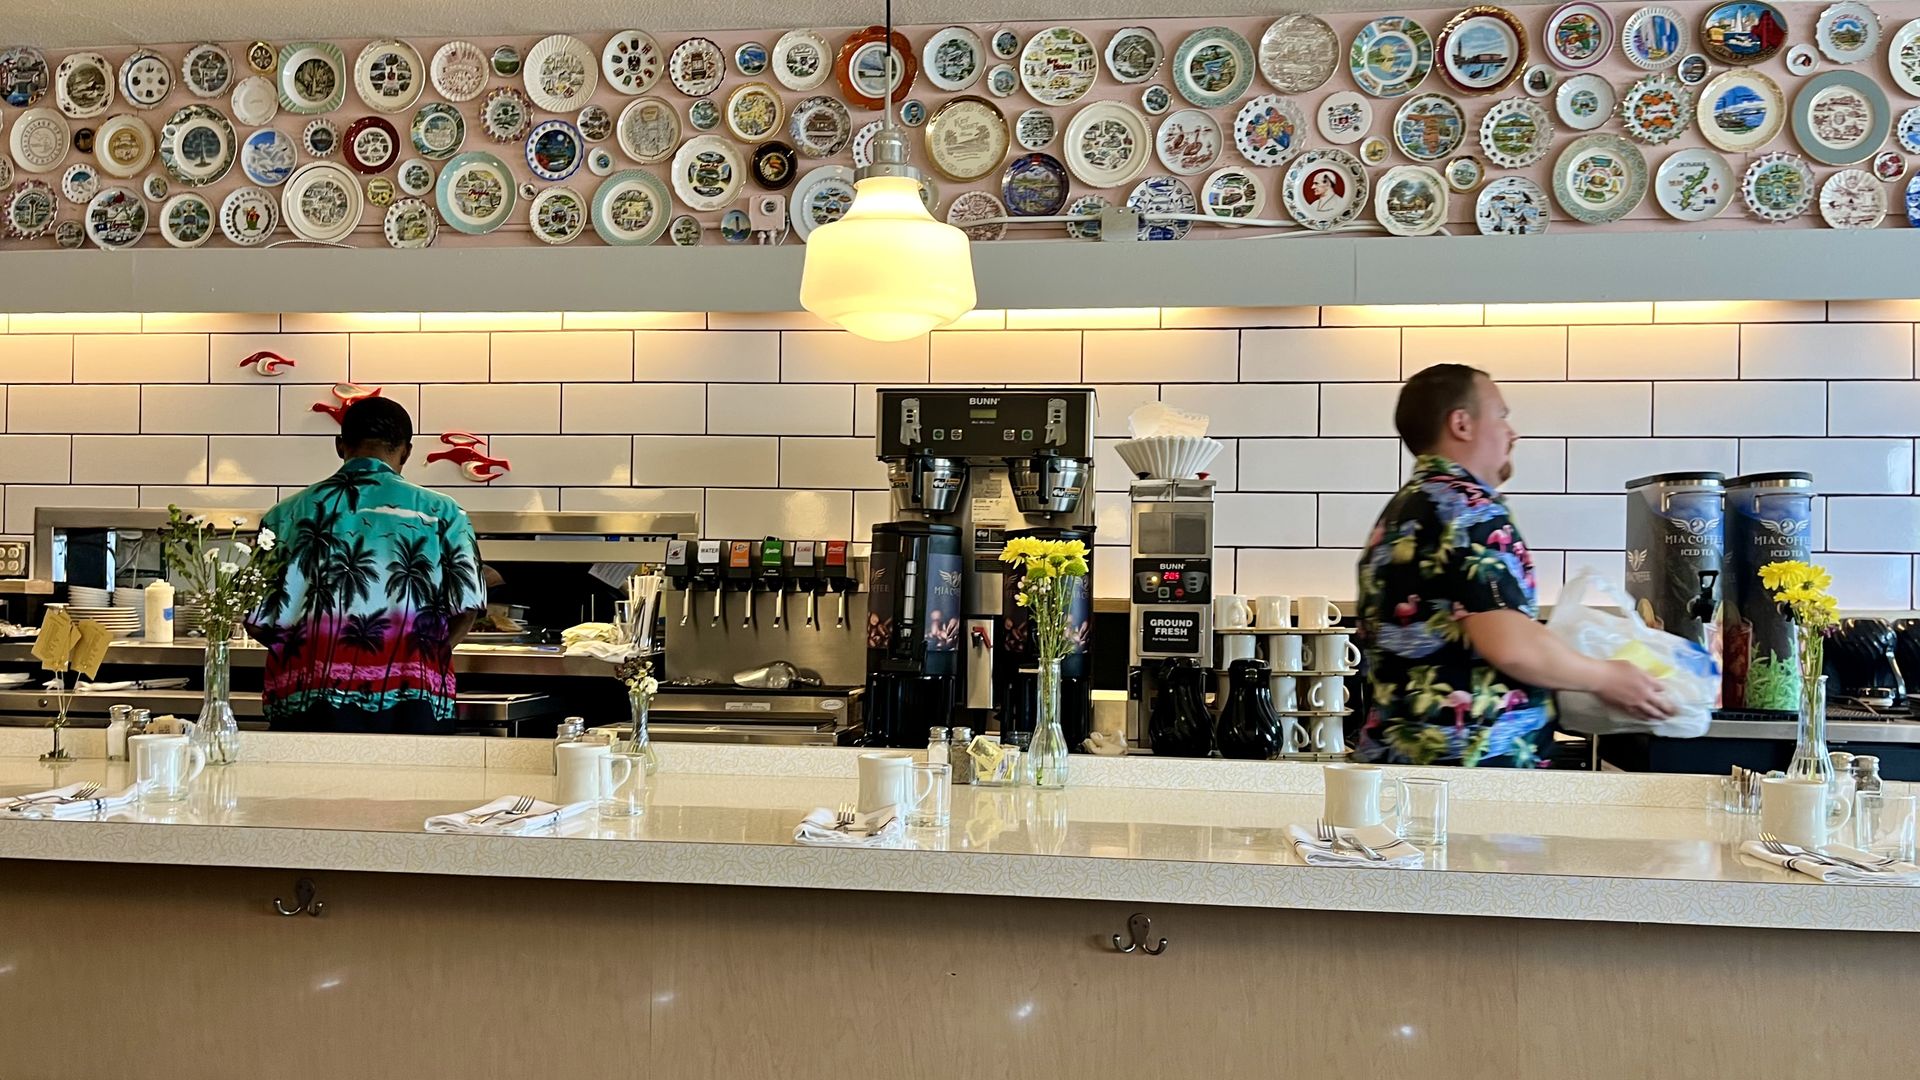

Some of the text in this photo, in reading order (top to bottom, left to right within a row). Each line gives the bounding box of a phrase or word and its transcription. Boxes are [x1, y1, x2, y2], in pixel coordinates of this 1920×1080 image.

[969, 397, 998, 405] BUNN
[1665, 535, 1686, 544] MIA
[1754, 536, 1776, 546] MIA
[1150, 618, 1193, 627] GROUND
[1155, 627, 1188, 635] FRESH
